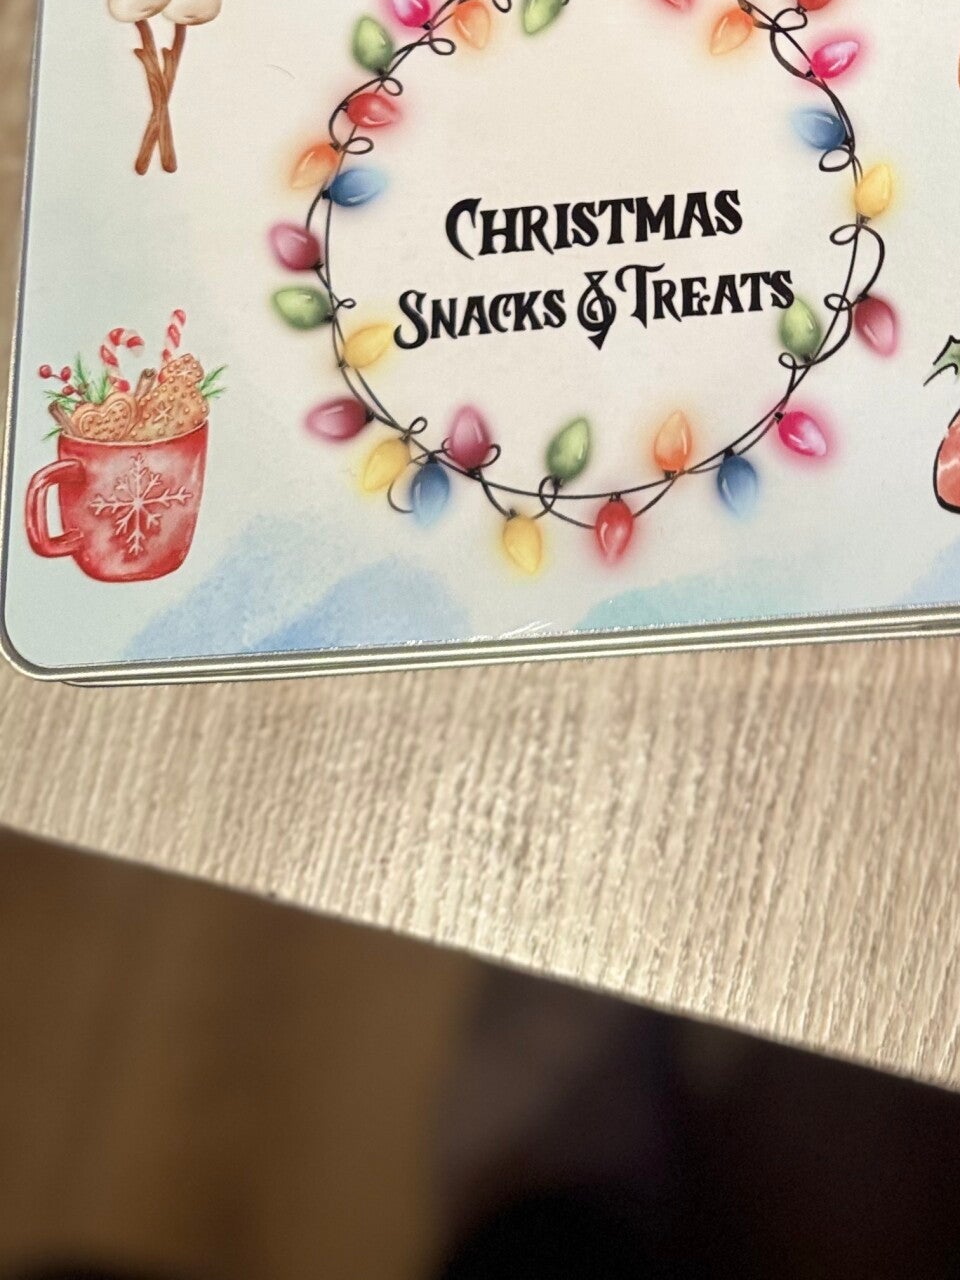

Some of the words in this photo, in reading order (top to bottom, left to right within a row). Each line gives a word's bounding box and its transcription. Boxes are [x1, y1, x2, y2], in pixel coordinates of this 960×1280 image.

[445, 189, 743, 261] CHRISTMAS
[393, 289, 567, 350] SNACKS
[577, 270, 617, 351] &
[615, 262, 795, 329] TREATS
